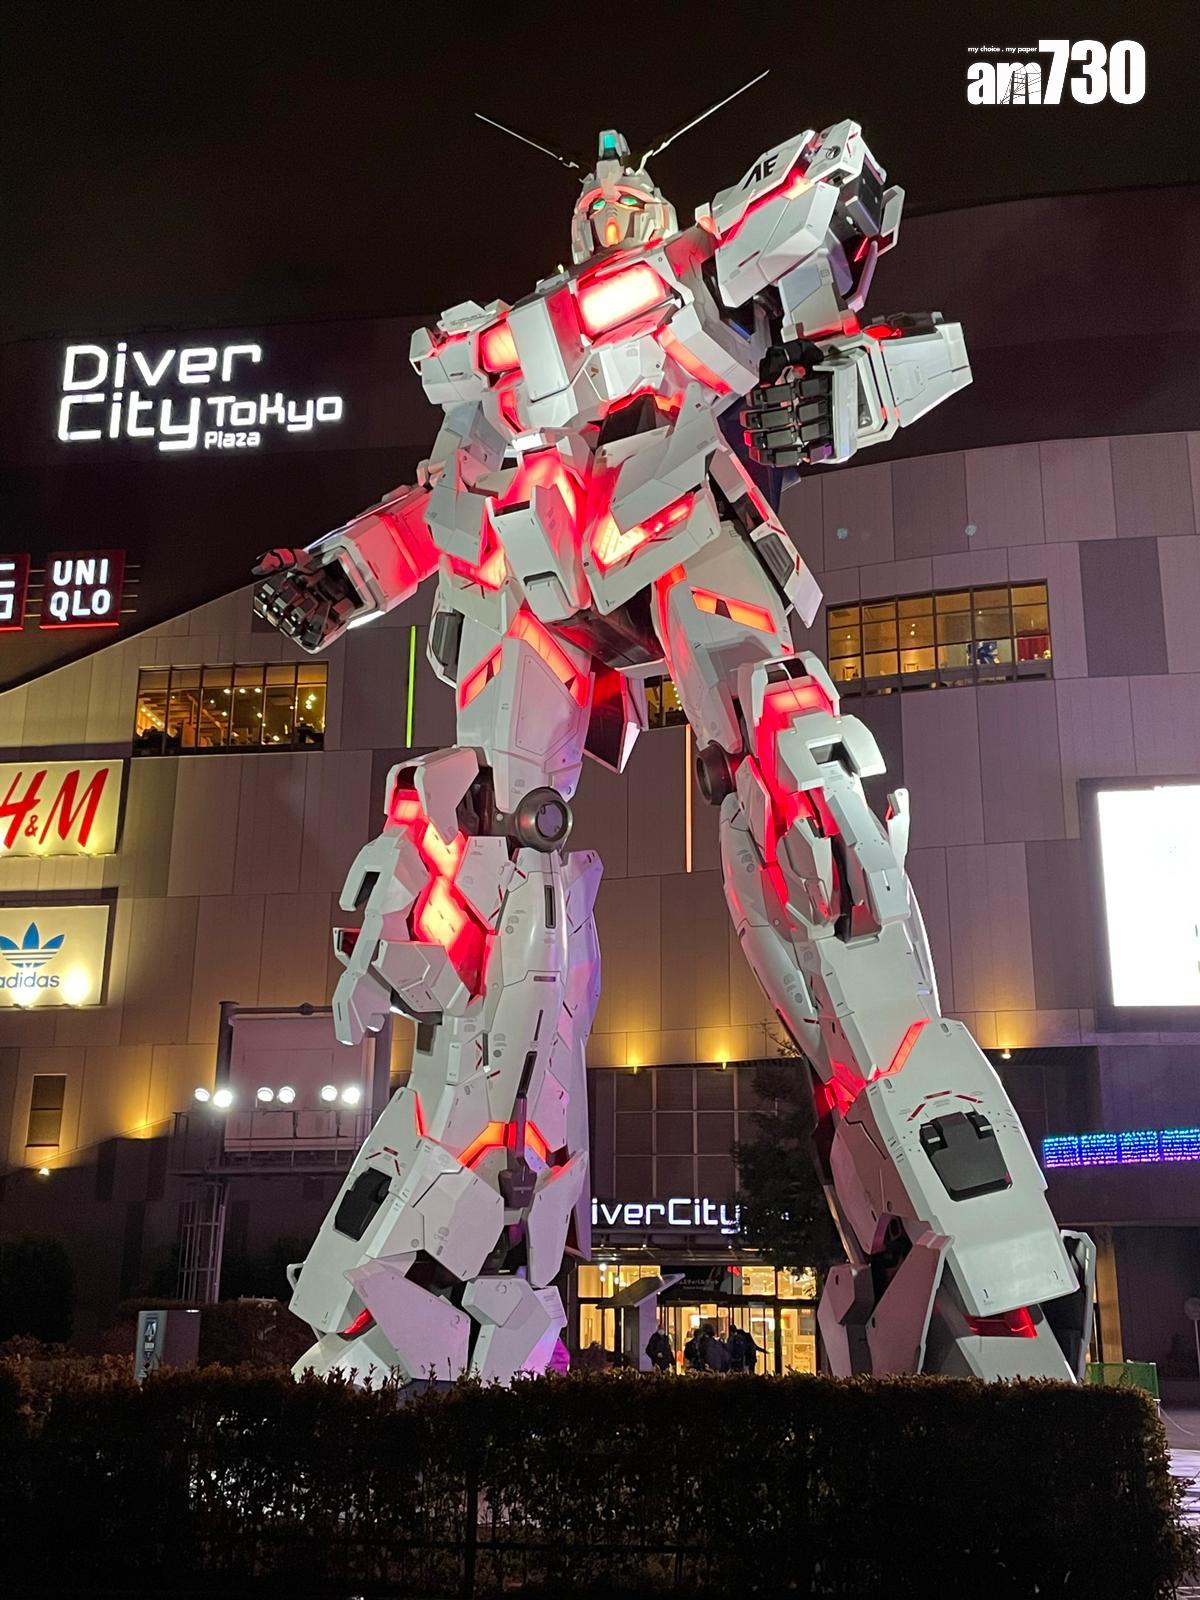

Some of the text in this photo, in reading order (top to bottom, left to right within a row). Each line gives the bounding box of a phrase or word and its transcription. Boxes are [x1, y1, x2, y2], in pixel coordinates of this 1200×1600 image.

[63, 342, 262, 391] Diver
[58, 390, 343, 451] City Tokyo
[204, 431, 261, 450] Plaza
[52, 558, 109, 586] UNI
[49, 588, 111, 622] QLO
[0, 768, 109, 849] H&M
[591, 1197, 742, 1235] iverCity
